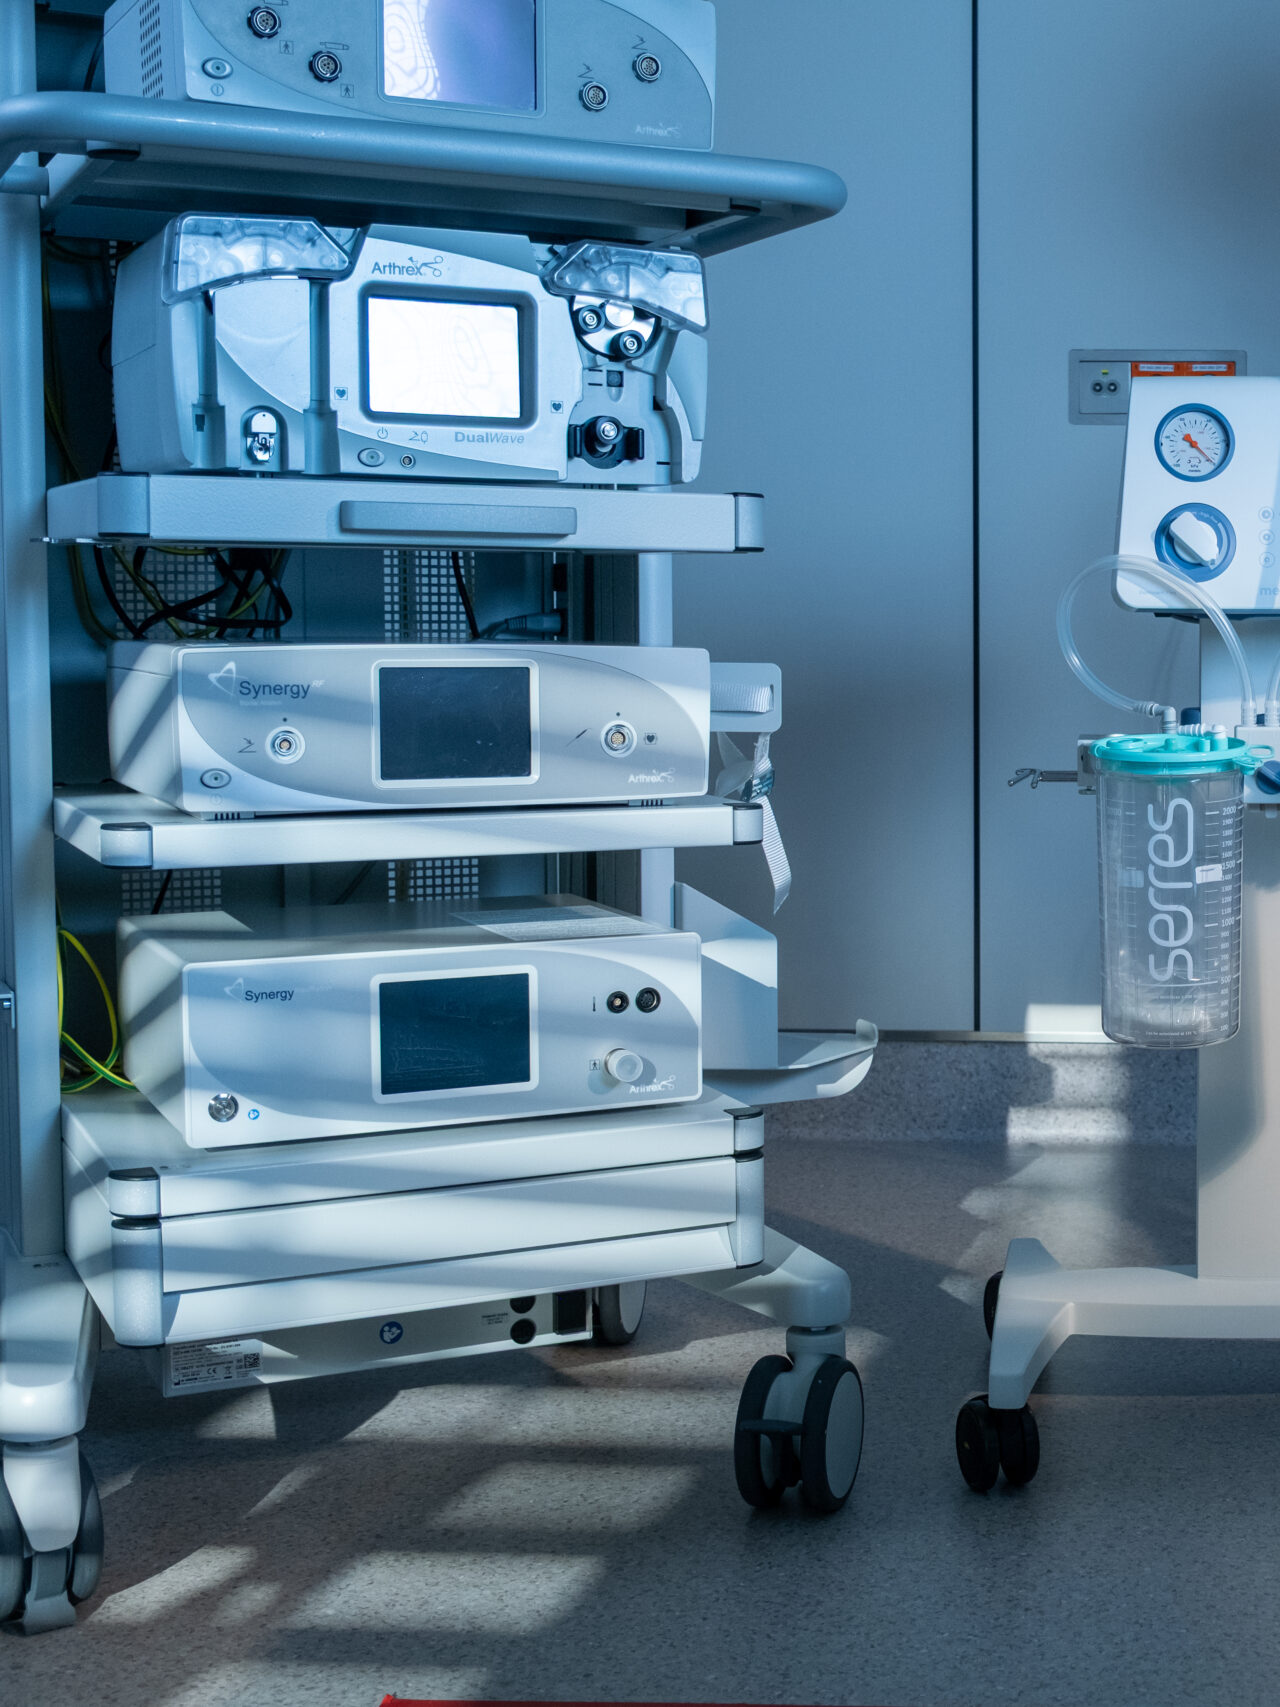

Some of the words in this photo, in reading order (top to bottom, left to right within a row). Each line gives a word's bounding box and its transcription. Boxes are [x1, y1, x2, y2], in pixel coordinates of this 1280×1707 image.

[371, 261, 423, 276] Arthrex
[454, 431, 525, 444] DualWave
[239, 680, 311, 699] Synergy
[628, 774, 663, 783] Arthrex
[1223, 806, 1236, 815] 2000
[1222, 860, 1235, 870] 1500
[1147, 798, 1193, 981] serres
[1222, 917, 1234, 927] 1000
[1221, 975, 1231, 984] 500
[245, 990, 294, 1003] Synergy
